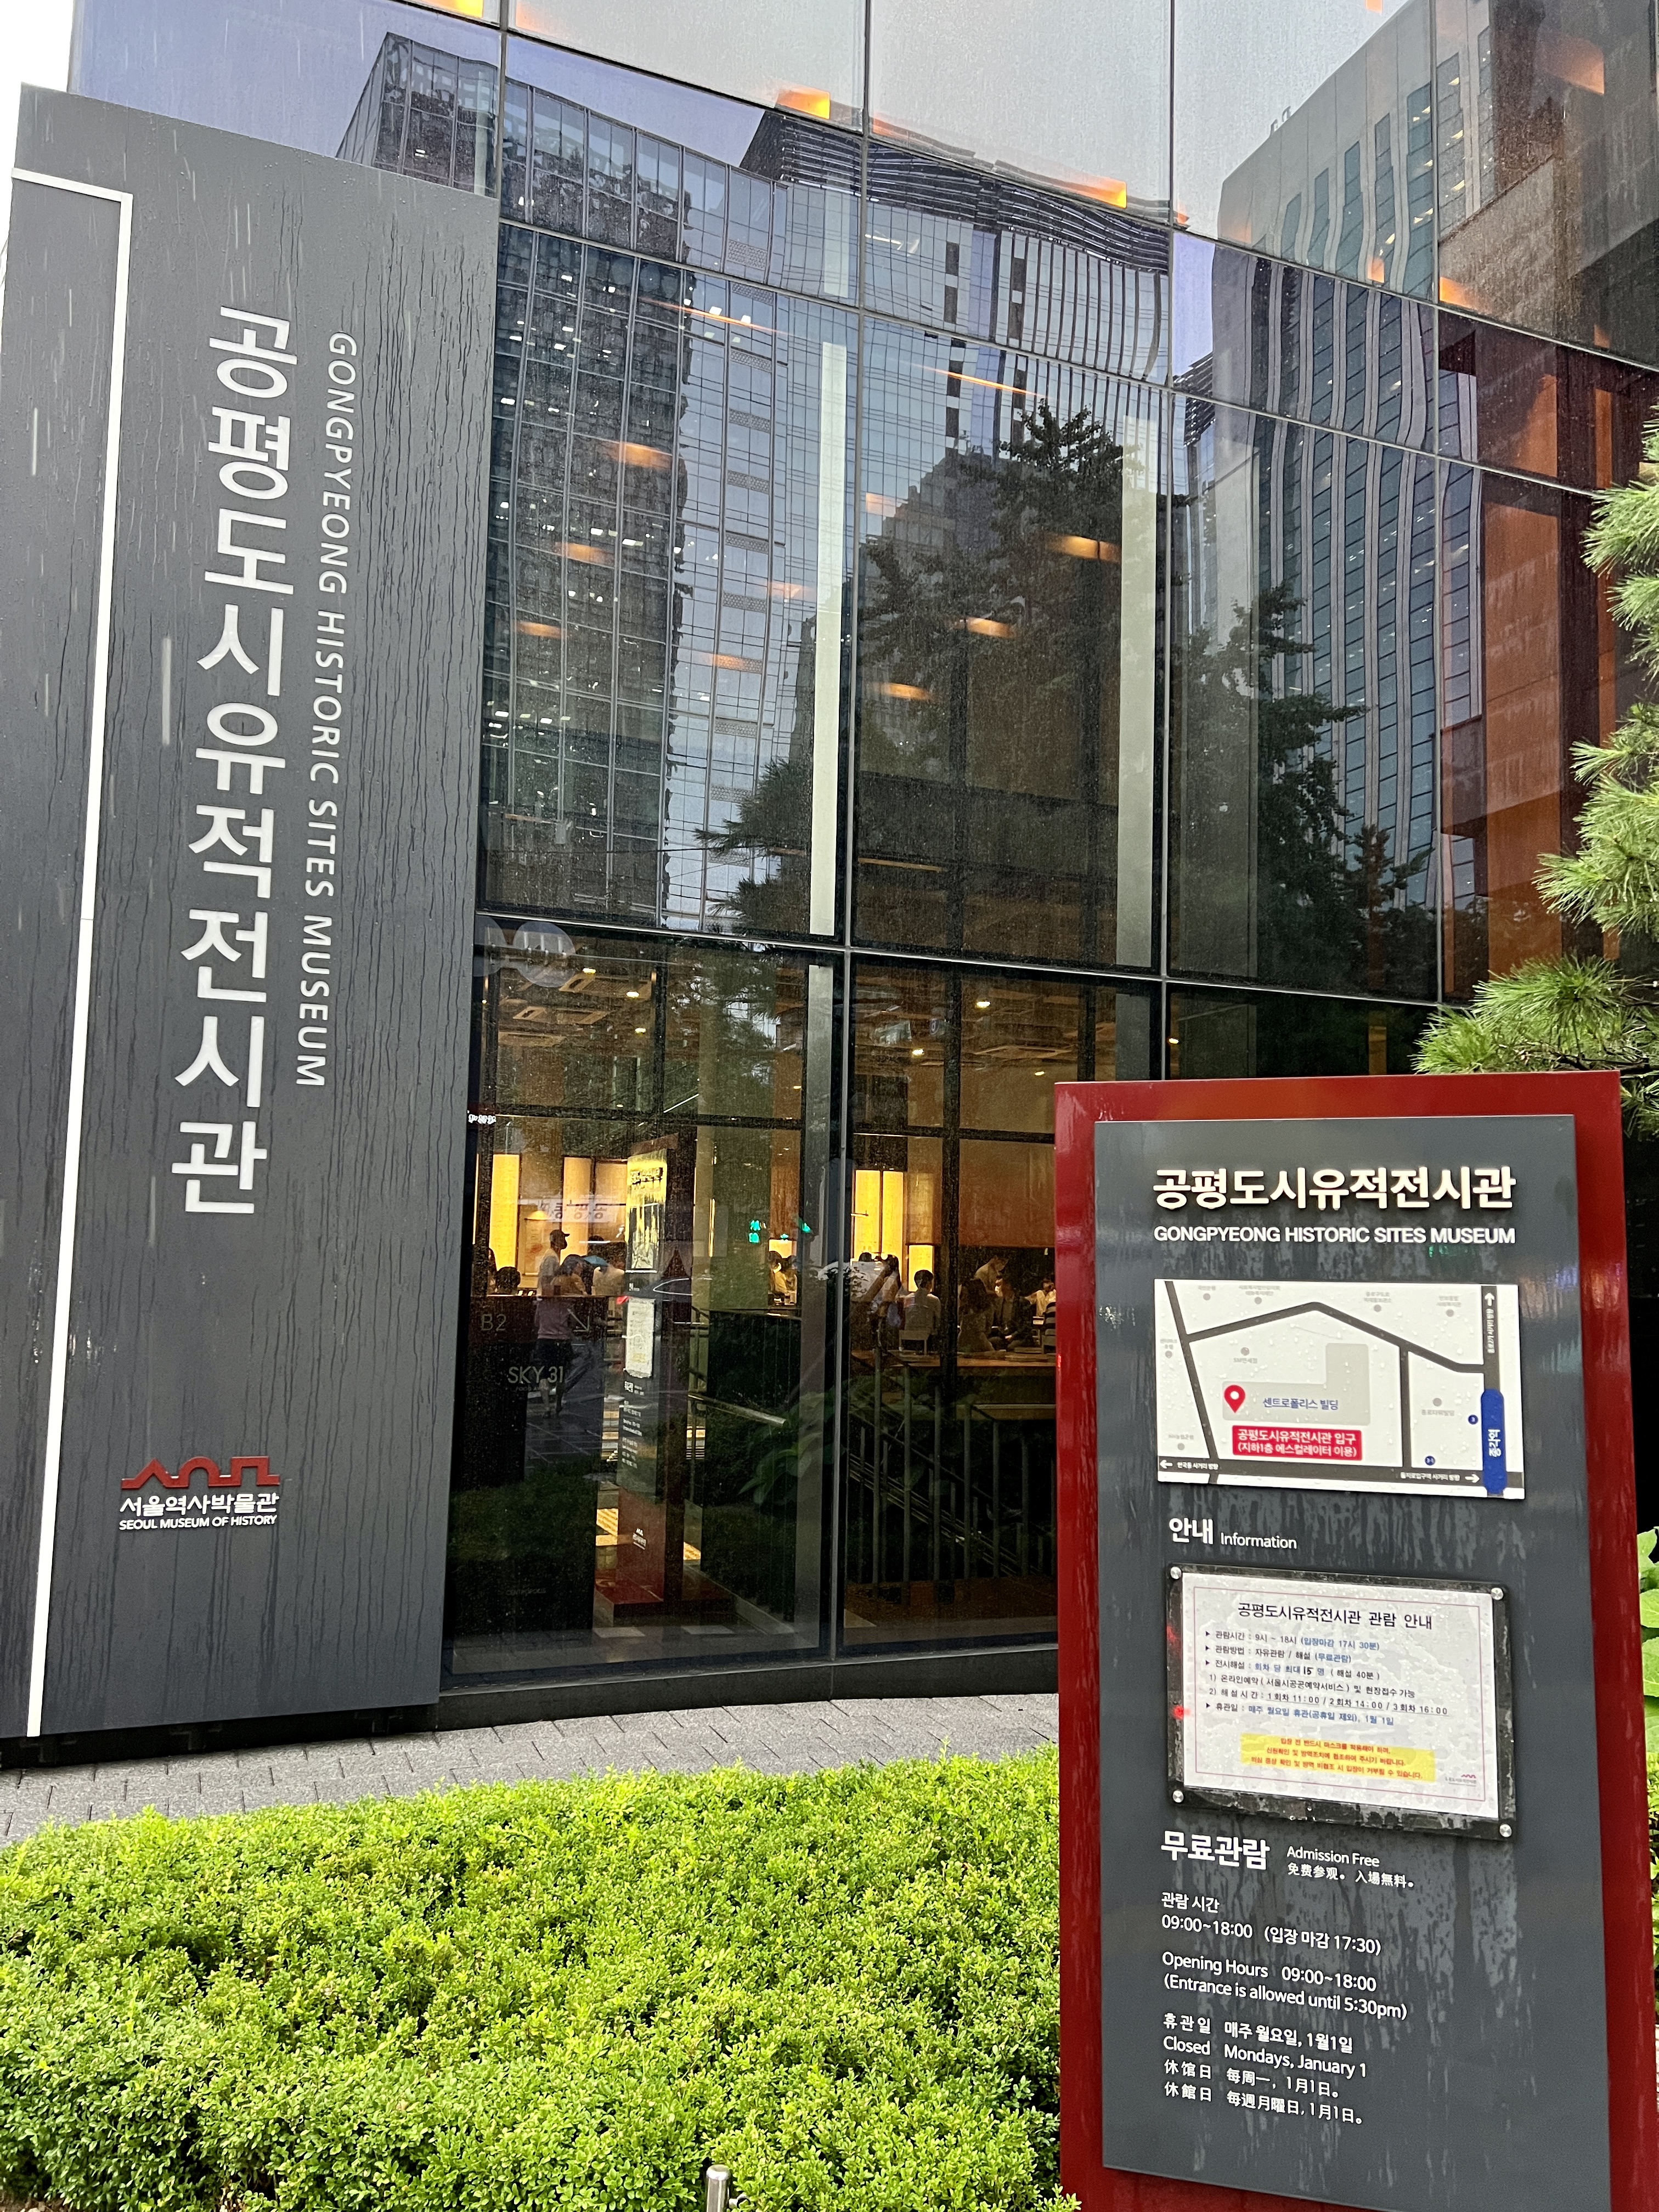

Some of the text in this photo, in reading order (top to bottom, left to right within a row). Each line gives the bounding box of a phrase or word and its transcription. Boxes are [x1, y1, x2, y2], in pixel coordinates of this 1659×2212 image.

[296, 332, 357, 1086] GONGPYEONG HISTORIC SITES MUSEUM
[171, 306, 297, 1214] 공평도시유적전시관
[1153, 1166, 1516, 1210] 공평도시유적전시관
[1154, 1226, 1516, 1244] GONGPYEONG HISTORIC SITES MUSEUM
[481, 1314, 507, 1331] B2
[507, 1365, 564, 1384] SKY 31
[1262, 1397, 1339, 1410] 센트로폴리스 빌딩
[1238, 1429, 1357, 1446] 공평도시유적전시관 입구
[1488, 1429, 1502, 1458] 종각역
[1238, 1442, 1357, 1458] (지하1층 에스컬레이터 이용)
[120, 1493, 280, 1517] 서울역사박물관
[119, 1515, 277, 1530] SEOUL MUSEUM OF HISTORY
[1168, 1517, 1297, 1550] 안내 Information
[1238, 1602, 1432, 1630] 공평도시유적전시관 관람 안내
[1215, 1630, 1245, 1641] 관람시간
[1281, 1636, 1297, 1645] 18시
[1301, 1637, 1335, 1648] (입장마감
[1339, 1640, 1356, 1649] 17시
[1359, 1641, 1380, 1651] 30분)
[1215, 1645, 1245, 1655] 관람방법
[1255, 1648, 1285, 1658] 자유관람
[1295, 1651, 1310, 1660] 해설
[1315, 1652, 1351, 1663] (무료관람)
[1215, 1660, 1245, 1669] 전시해설
[1255, 1662, 1269, 1672] 회차
[1303, 1667, 1314, 1675] 15
[1356, 1671, 1374, 1680] 40분
[1366, 1686, 1397, 1696] 현장접수
[1400, 1689, 1415, 1699] 가능
[1215, 1702, 1238, 1712] 휴관일
[1248, 1705, 1263, 1714] 매주
[1160, 1830, 1270, 1870] 무료관람
[1286, 1846, 1380, 1867] Admission Free
[1287, 1862, 1414, 1888] 免费参观。 入場無料。
[1161, 1892, 1220, 1914] 관람 시간
[1161, 1914, 1382, 1956] 09:00~18:00 (입장 마감 17:30)
[1162, 1951, 1377, 1993] Opening Hours 09:00~18:00
[1164, 1974, 1408, 2021] (Entrance is allowed until 5:30pm)
[1224, 2021, 1252, 2040] 매주
[1256, 2025, 1303, 2048] 월요일,
[1307, 2032, 1353, 2054] 1월1일
[1163, 2036, 1367, 2079] Closed Mondays, January 1
